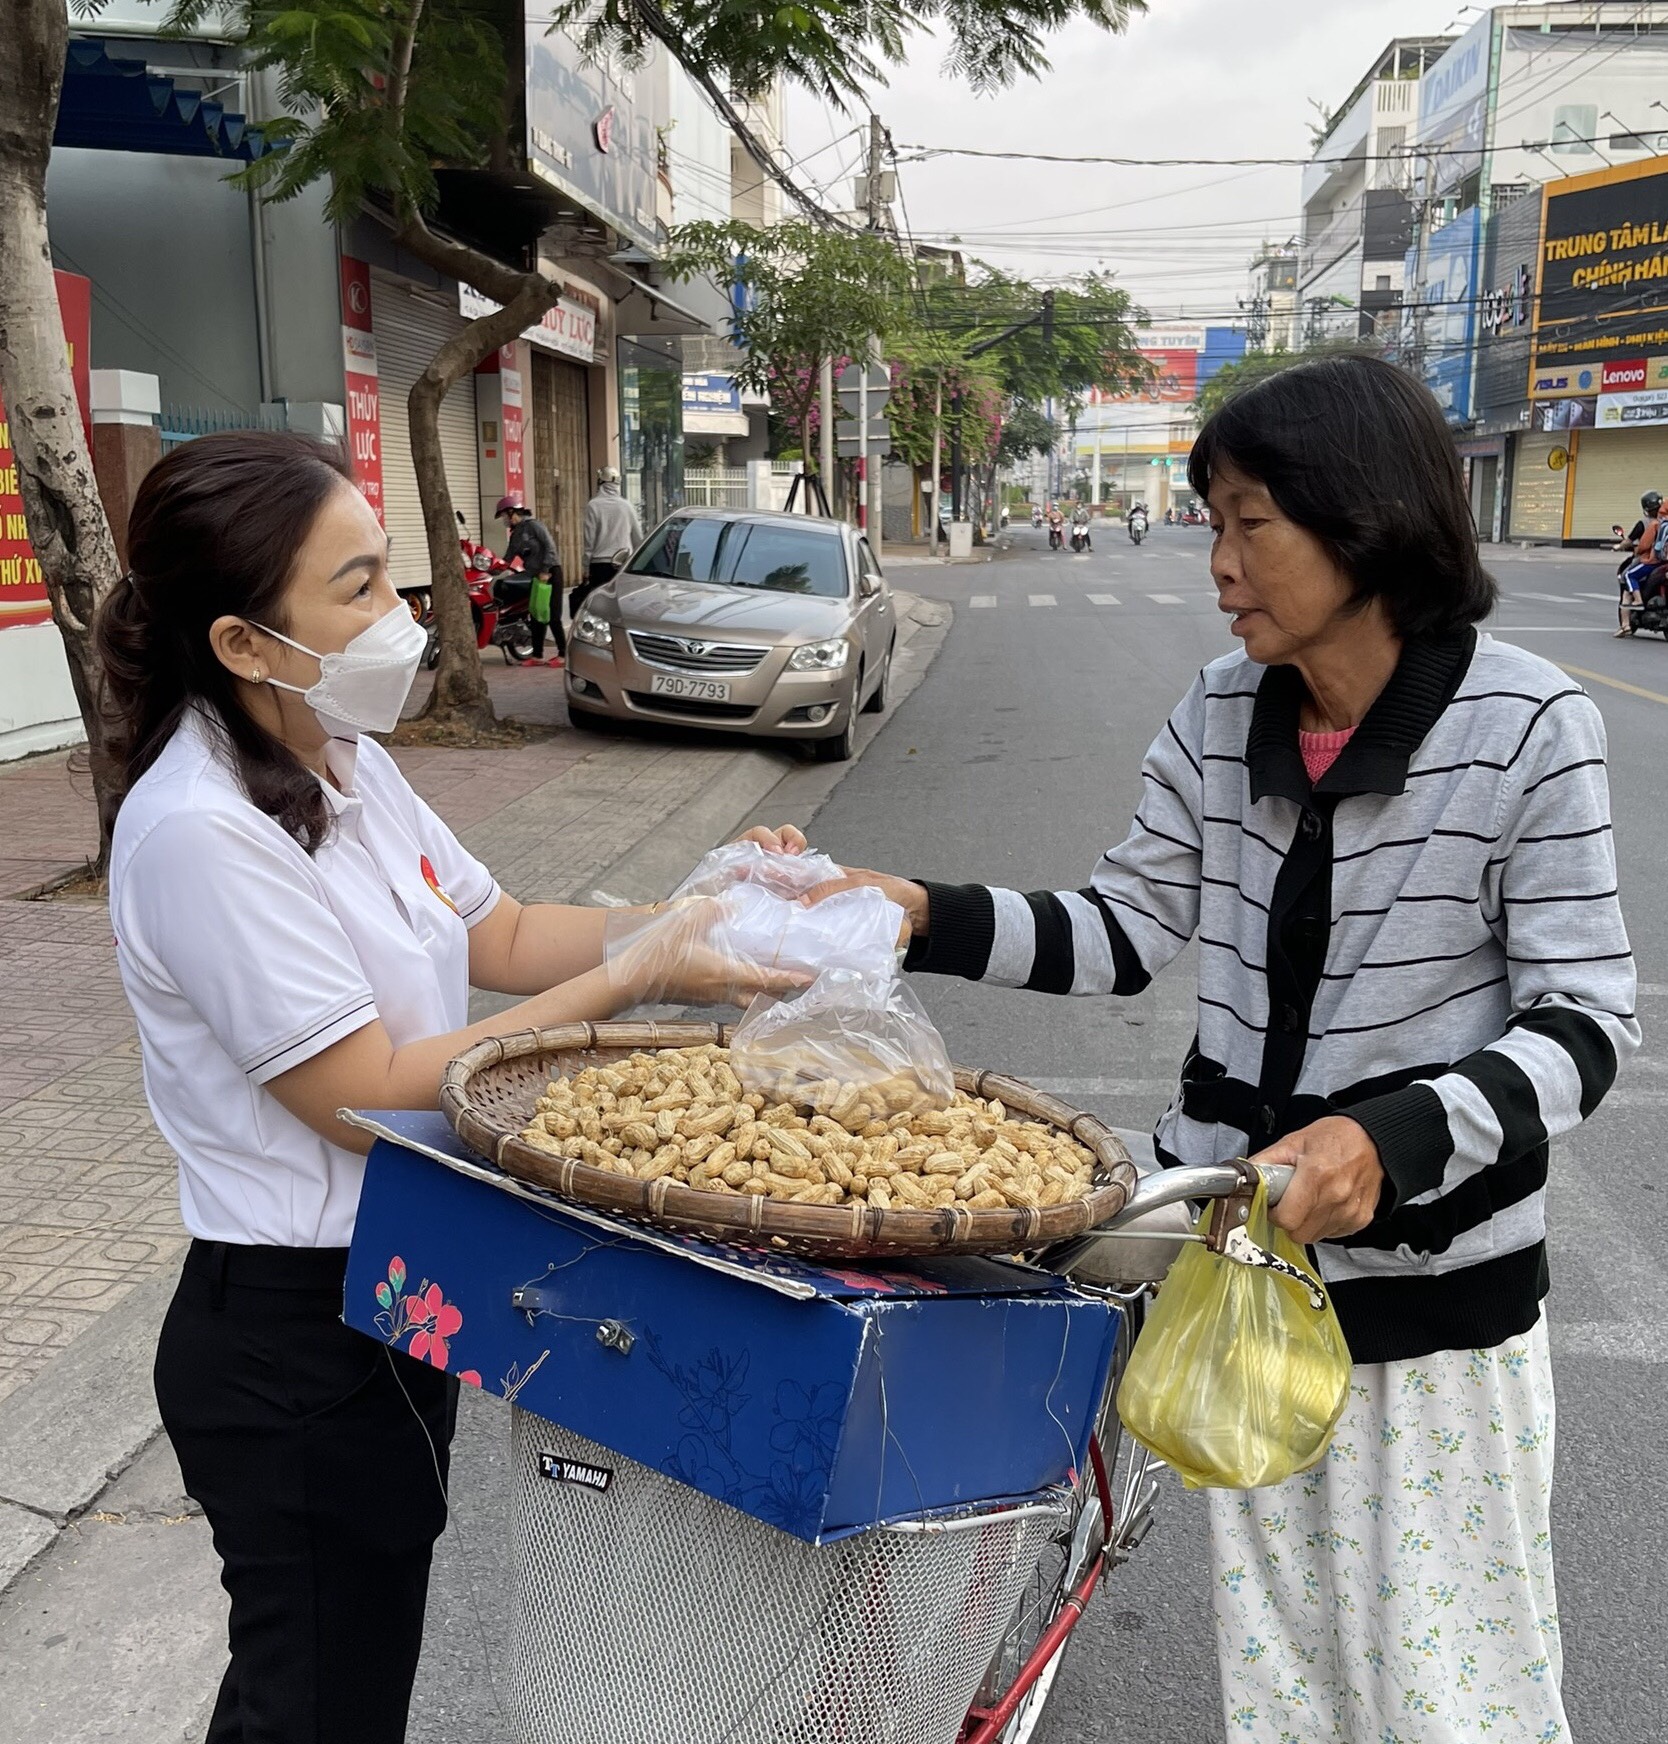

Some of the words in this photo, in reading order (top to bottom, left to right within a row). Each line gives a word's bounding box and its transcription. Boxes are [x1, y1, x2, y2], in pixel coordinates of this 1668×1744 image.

[1545, 231, 1607, 262] TRUNG
[1609, 221, 1649, 250] TÂM
[1533, 377, 1568, 391] ASUS
[1602, 369, 1645, 384] Lenovo
[350, 384, 378, 422] THỦY
[356, 429, 377, 469] LỰC
[0, 553, 22, 585] HỨ
[562, 1462, 608, 1488] YAMAHA
